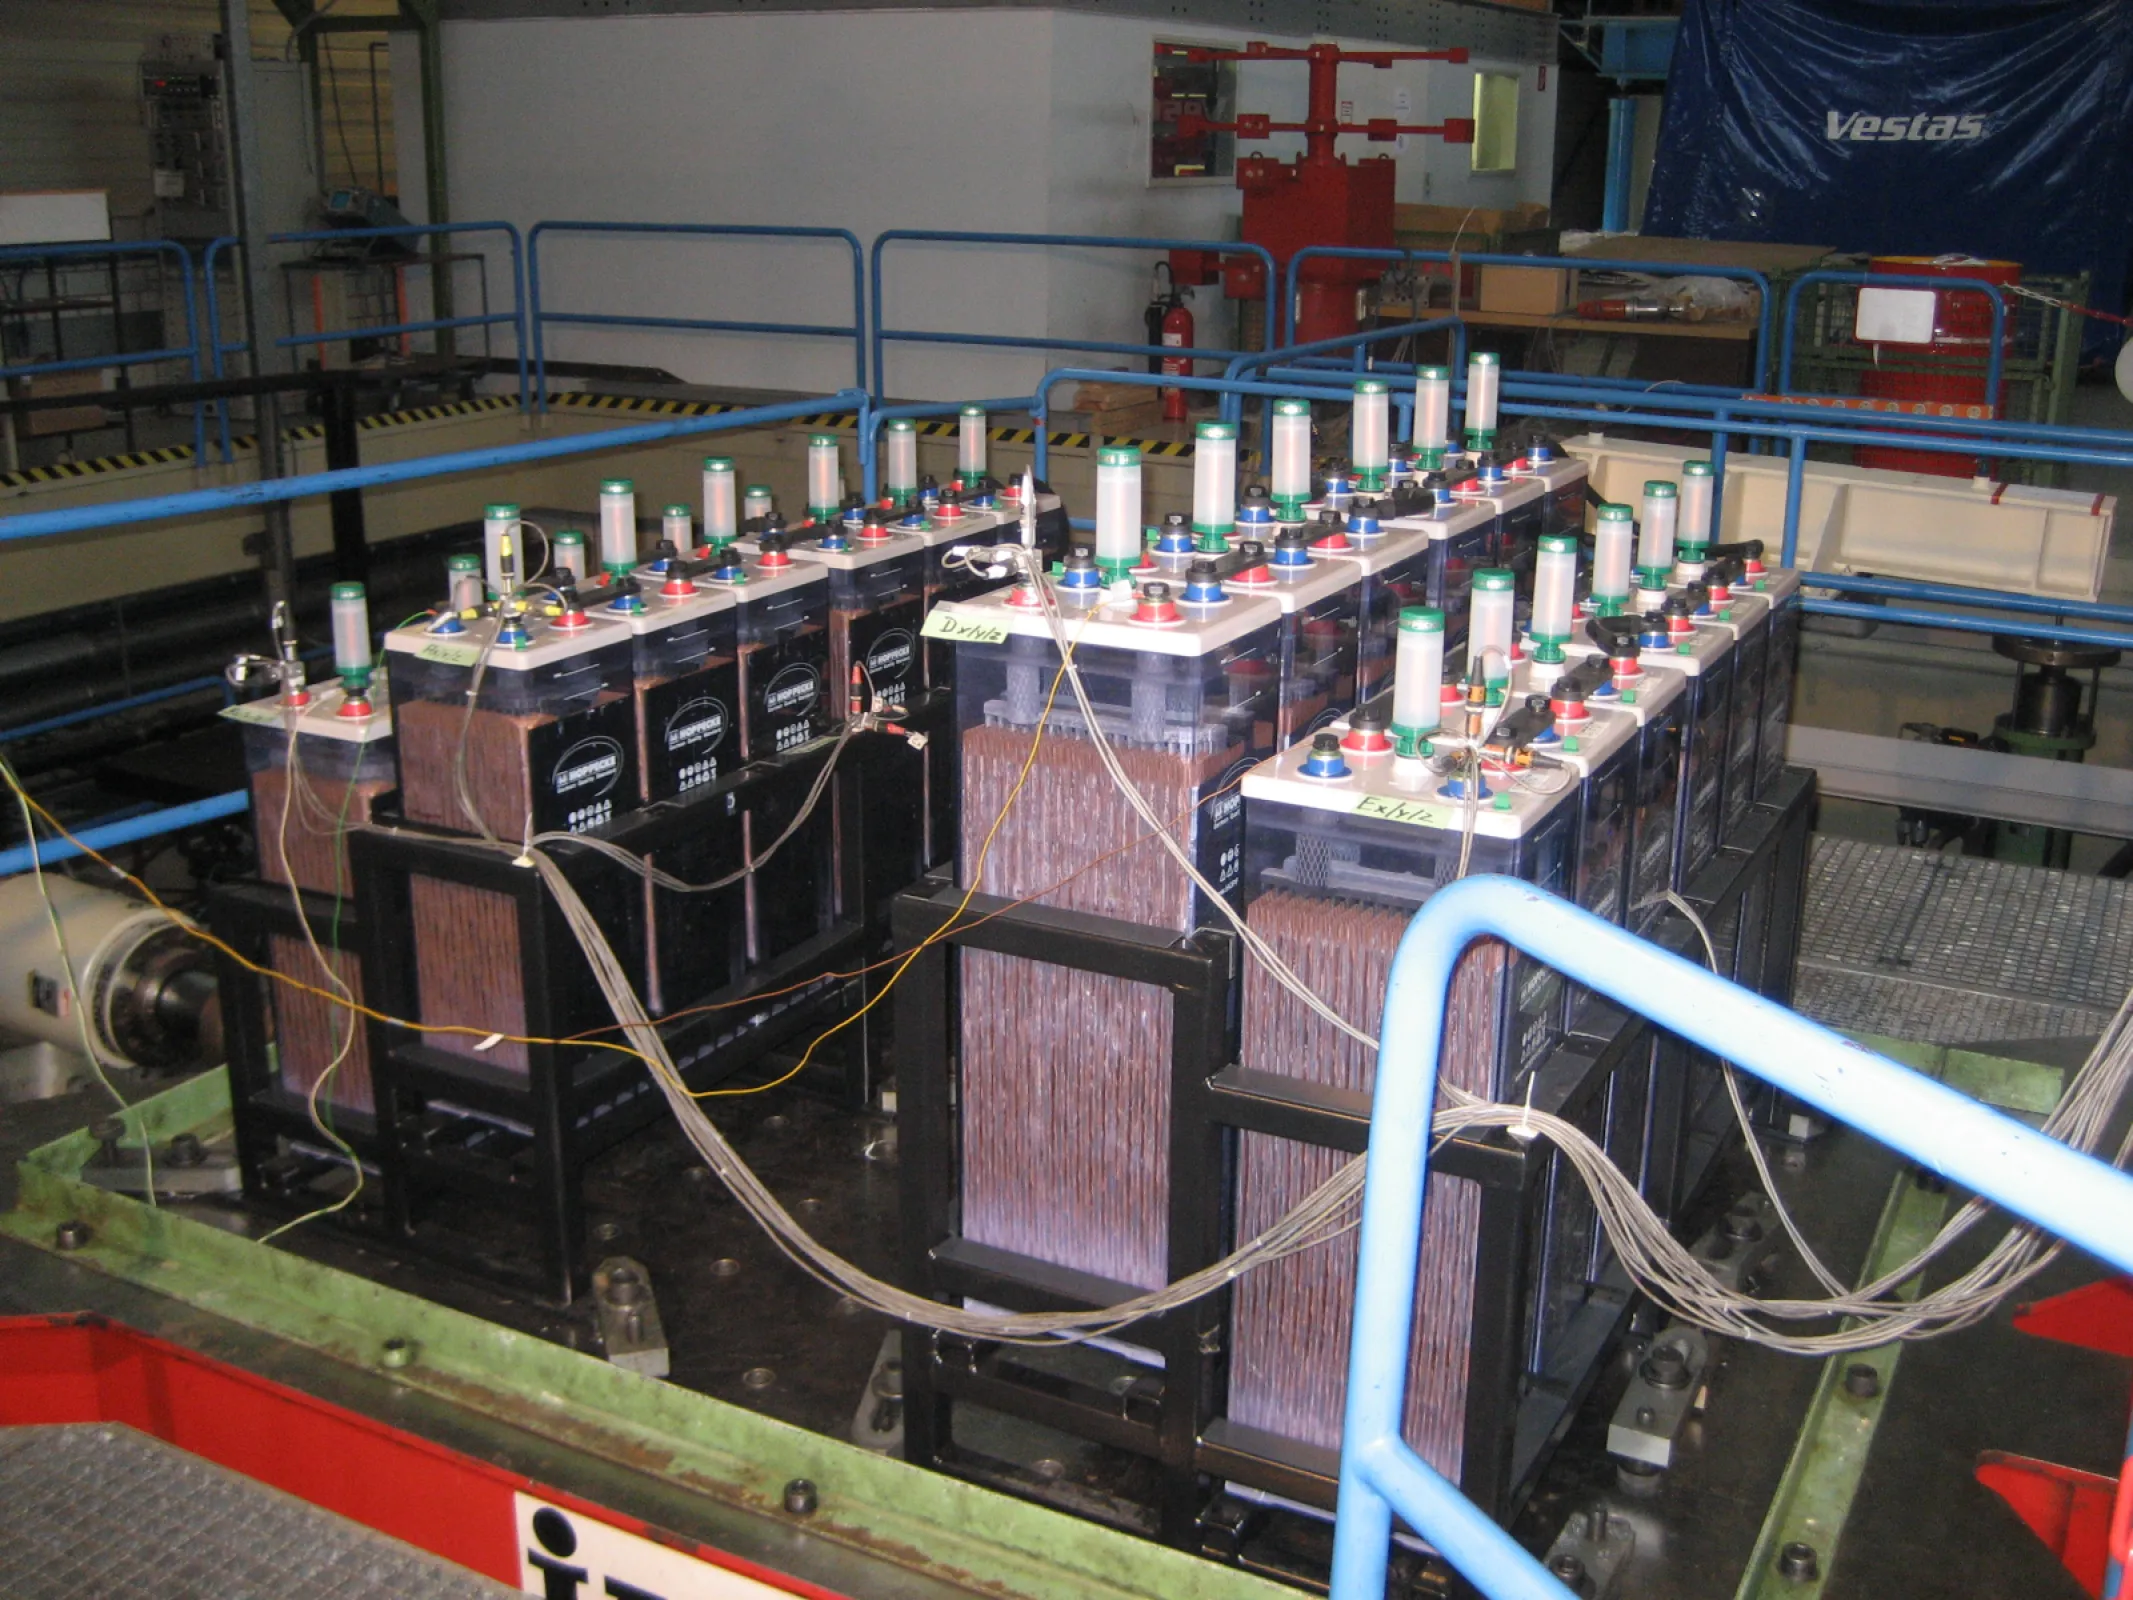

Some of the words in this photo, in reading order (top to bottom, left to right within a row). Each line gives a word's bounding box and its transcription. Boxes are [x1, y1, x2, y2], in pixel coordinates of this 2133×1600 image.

[1827, 111, 1987, 141] Vestas
[776, 680, 814, 703] HOPPECKE
[679, 715, 722, 741] HOPPECKE
[569, 753, 617, 782] HOPPECKE
